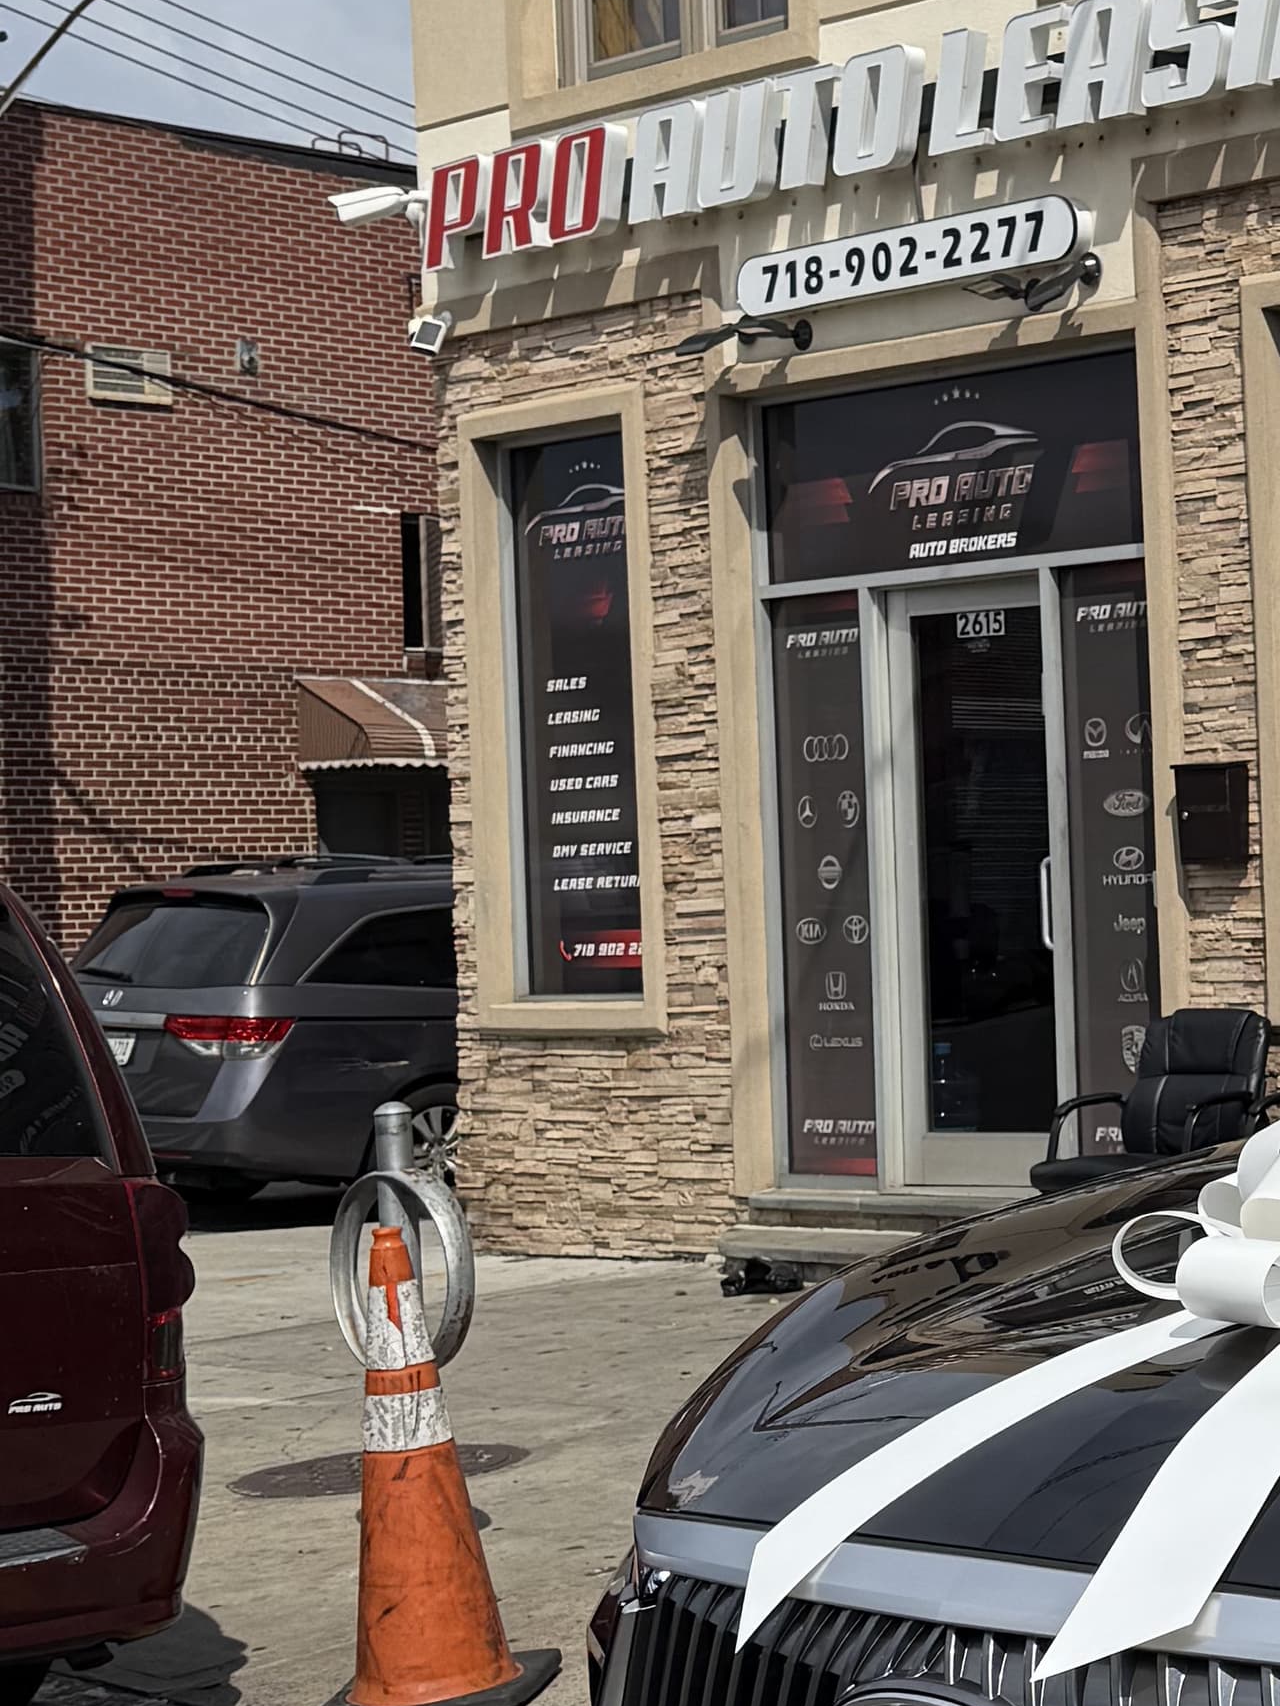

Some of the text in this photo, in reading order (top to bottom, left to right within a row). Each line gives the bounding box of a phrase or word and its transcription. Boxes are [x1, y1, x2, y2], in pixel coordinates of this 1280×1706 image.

[424, 122, 629, 272] PRO
[627, 43, 926, 224] AUTO
[761, 210, 1047, 304] 718-902-2277
[890, 464, 1034, 511] PRO AUTO
[912, 503, 1013, 530] LEASING
[538, 515, 625, 546] PRO AUT
[553, 540, 622, 560] LEASING
[909, 532, 1018, 559] AUTO BROKERS
[1076, 601, 1147, 622] PRO AUT
[959, 611, 1002, 636] 2615
[786, 627, 859, 649] PRO AUTO
[546, 677, 587, 692] SALES
[548, 709, 600, 725] LEASING
[549, 741, 614, 758] FINANCING
[550, 774, 618, 791] USED CARS
[551, 808, 620, 825] INSURANCE
[552, 841, 632, 858] DMV SERVICE
[553, 874, 640, 891] LEASE RETUR
[1103, 873, 1153, 886] HYUNDA
[1113, 913, 1146, 934] Jeep
[574, 944, 595, 957] 718
[599, 942, 626, 956] 902
[819, 1002, 855, 1011] HONDA
[824, 1035, 863, 1048] LEXUS
[803, 1119, 875, 1134] PRO AUTO
[8, 1402, 62, 1415] PRO AUTO
